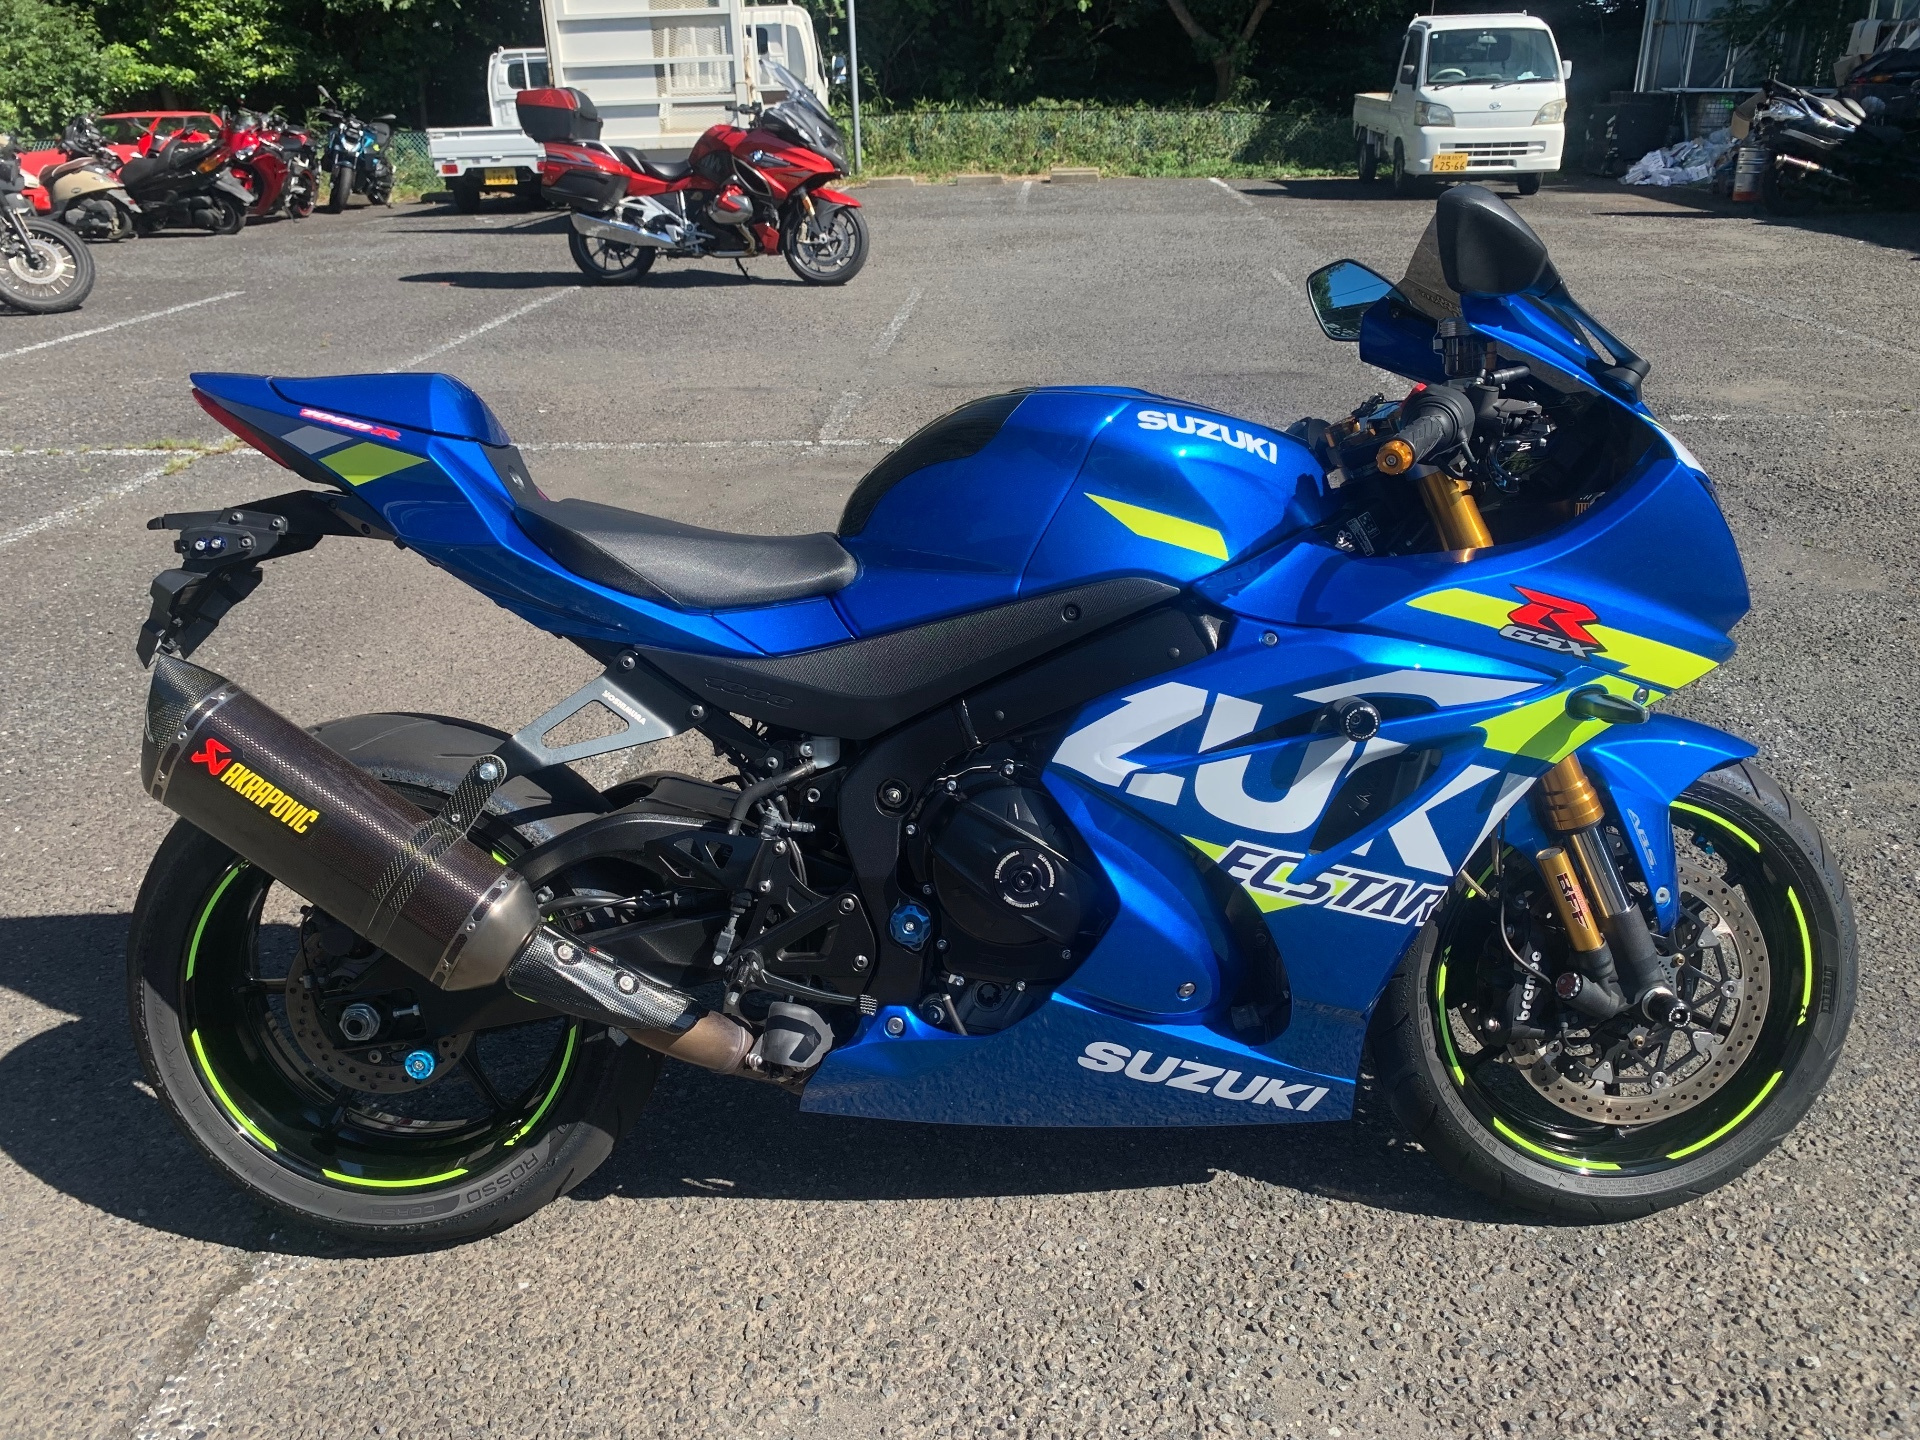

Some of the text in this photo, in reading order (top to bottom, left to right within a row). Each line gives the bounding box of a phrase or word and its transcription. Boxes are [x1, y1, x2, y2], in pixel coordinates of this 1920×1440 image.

[1137, 410, 1278, 465] SUZUKI
[1499, 624, 1597, 659] GSX
[1508, 584, 1602, 649] R
[1626, 807, 1657, 872] ABS
[1217, 841, 1449, 926] ECSTAR
[1555, 872, 1590, 930] BFF
[1077, 1041, 1330, 1112] SUZUKI
[466, 1152, 540, 1204] ROSSO
[370, 1204, 435, 1217] CORSA
